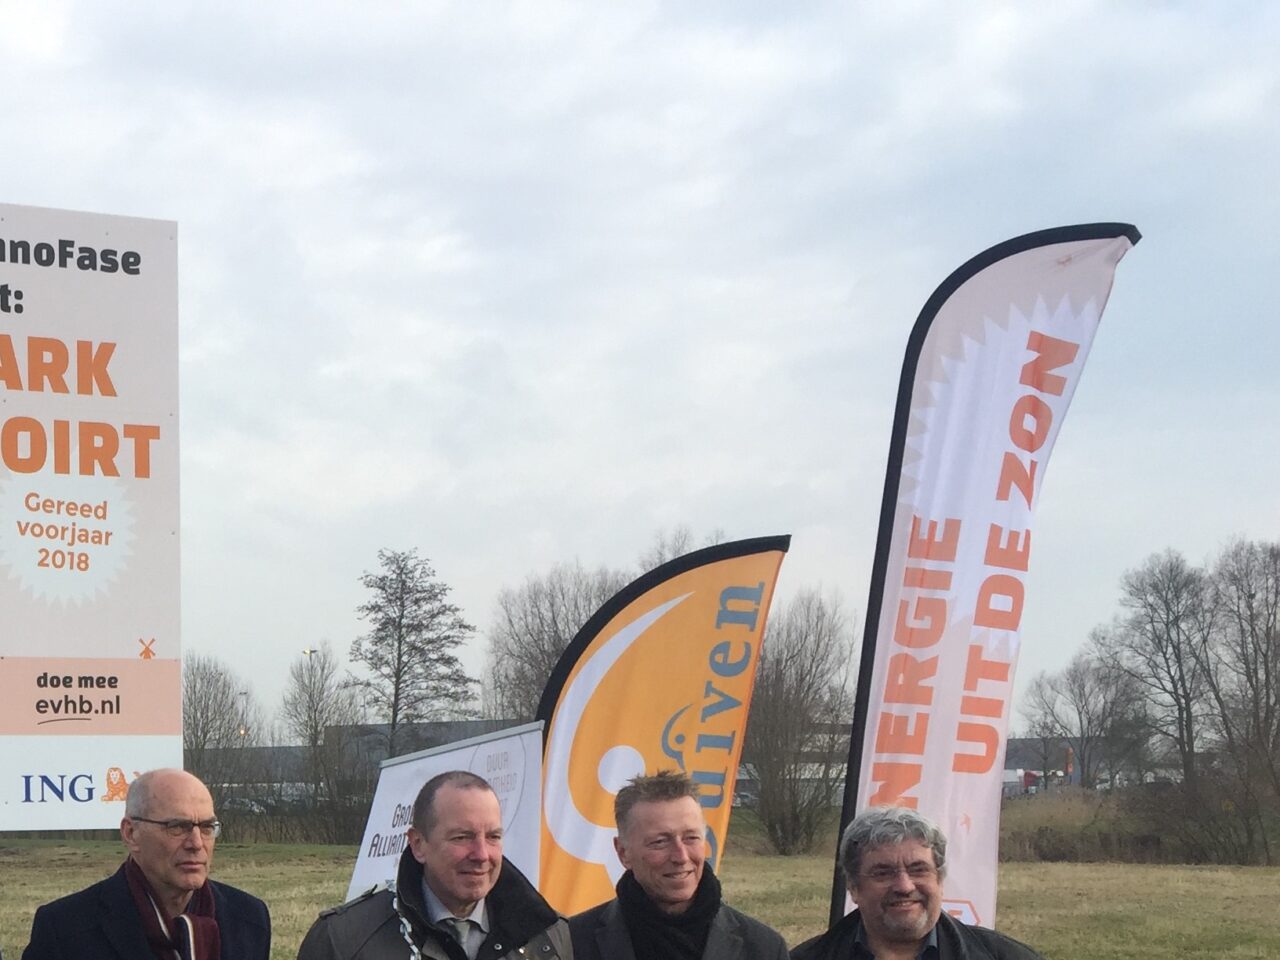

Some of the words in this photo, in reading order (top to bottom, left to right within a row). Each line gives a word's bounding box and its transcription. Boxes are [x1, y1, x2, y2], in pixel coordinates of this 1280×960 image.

[996, 330, 1080, 512] ZON
[23, 491, 109, 521] Gereed
[16, 517, 114, 549] voorjaar
[36, 547, 91, 573] 2018
[973, 523, 1032, 633] DE
[868, 514, 962, 809] NERGIE
[35, 670, 74, 690] doe
[77, 673, 119, 690] mee
[34, 694, 121, 716] evhb.nl
[950, 644, 1012, 775] UIT
[21, 773, 96, 803] ING
